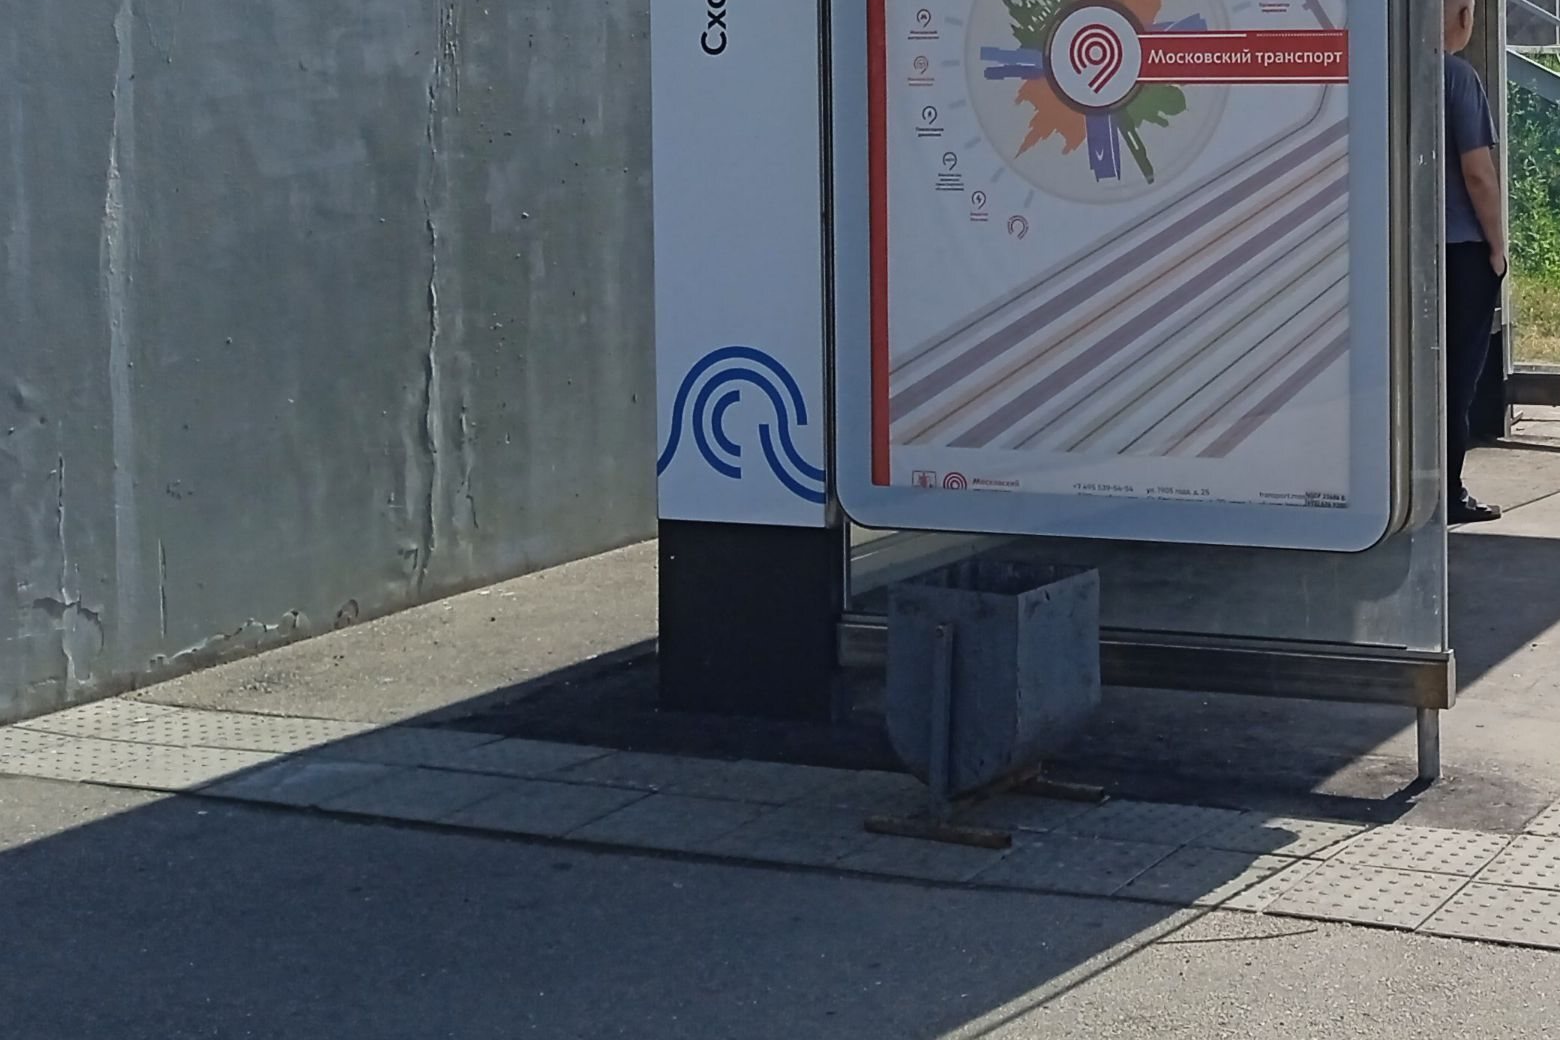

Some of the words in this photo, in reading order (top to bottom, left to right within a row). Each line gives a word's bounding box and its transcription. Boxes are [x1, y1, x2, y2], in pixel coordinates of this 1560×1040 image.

[1147, 48, 1252, 65] Московский
[1255, 50, 1343, 67] транспорт
[972, 477, 1020, 488] Московский
